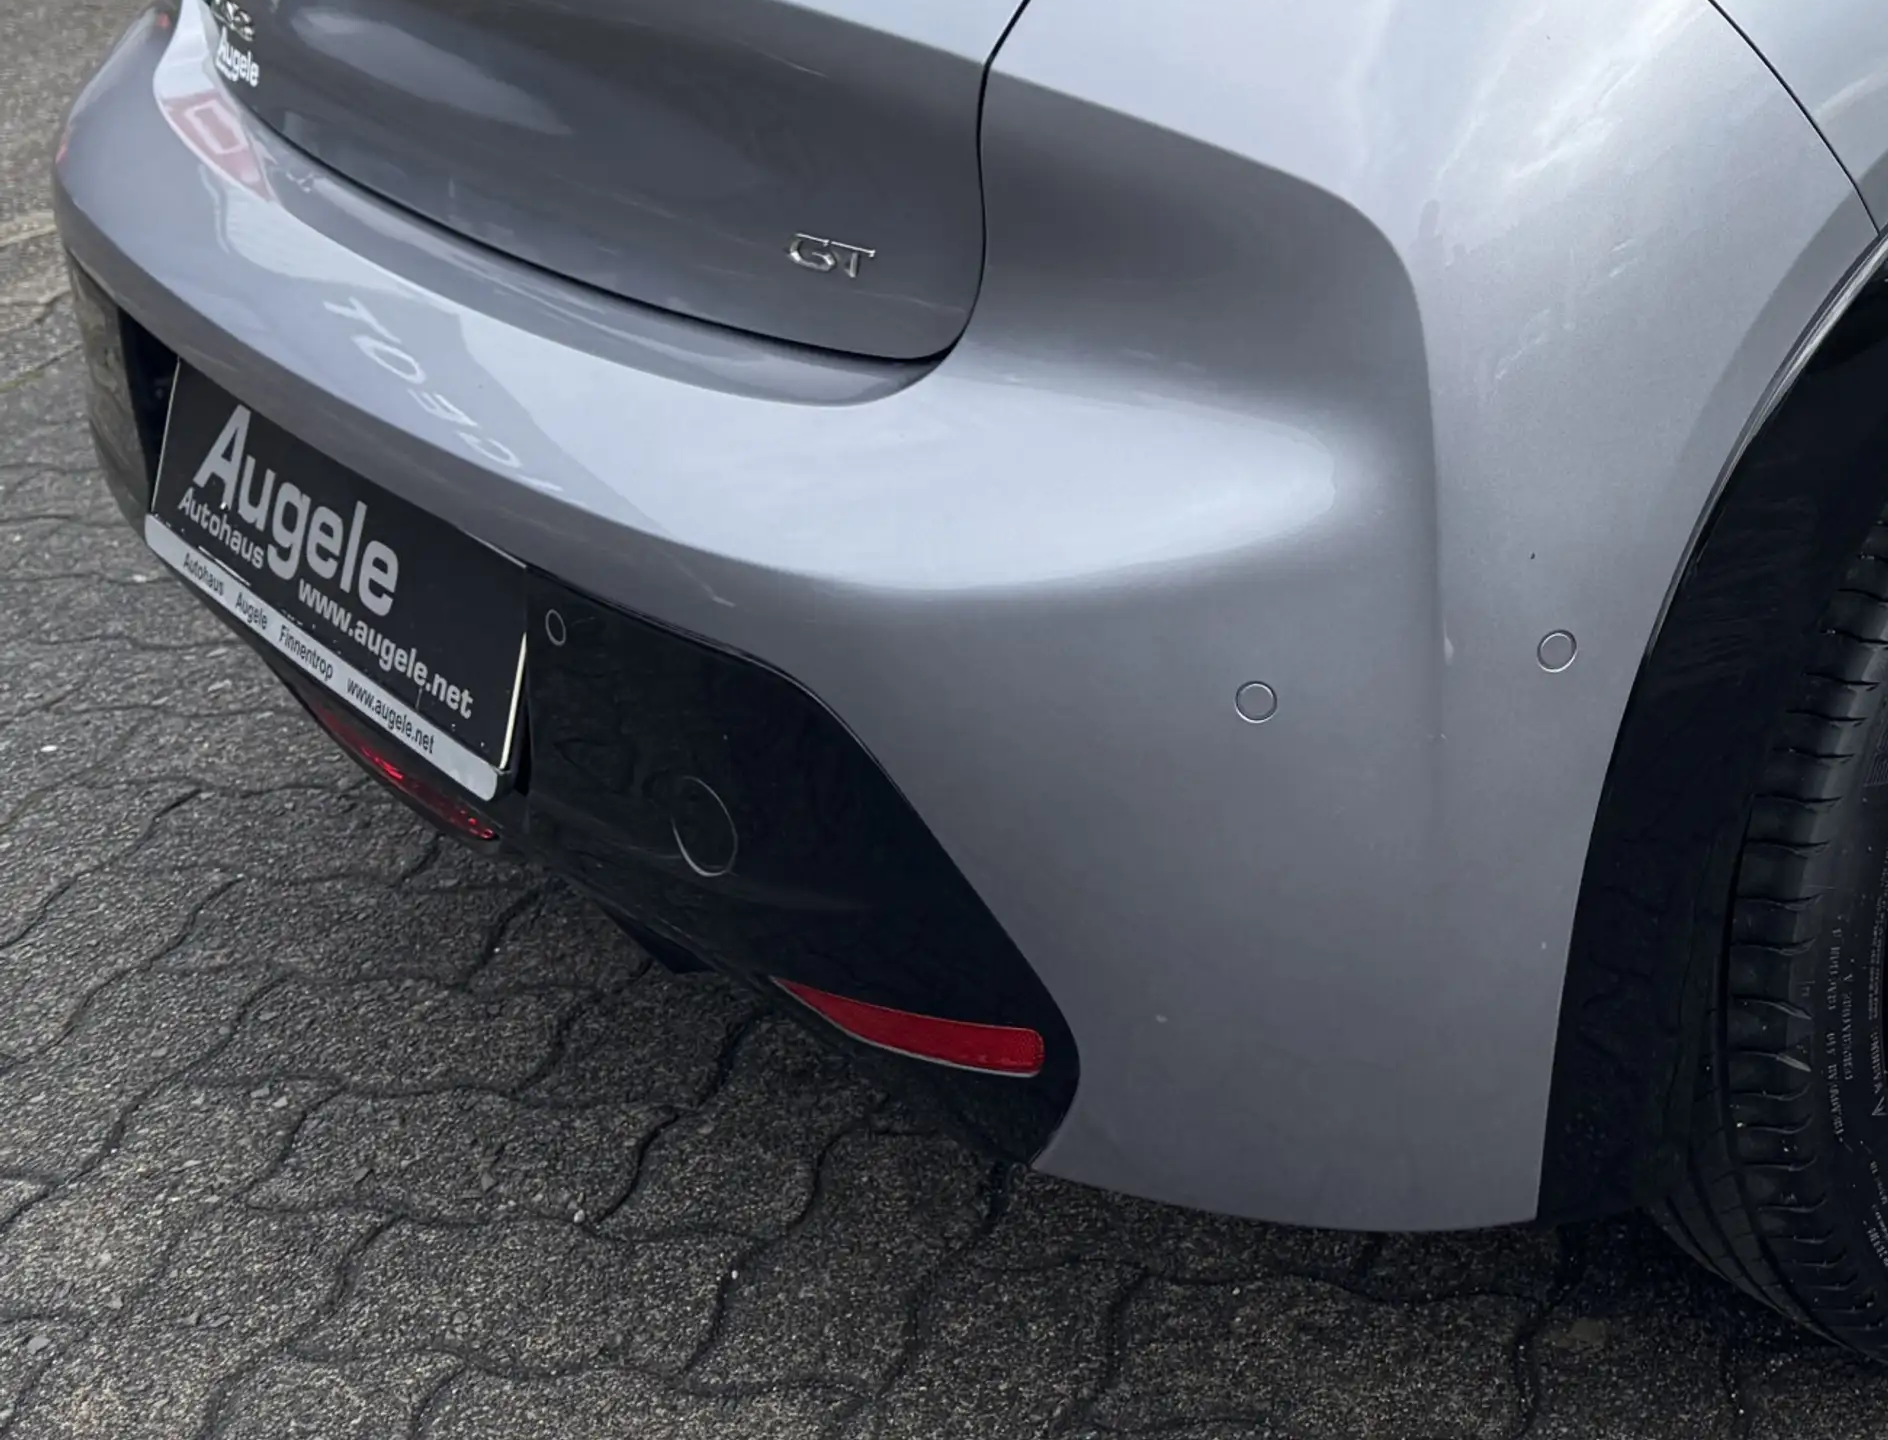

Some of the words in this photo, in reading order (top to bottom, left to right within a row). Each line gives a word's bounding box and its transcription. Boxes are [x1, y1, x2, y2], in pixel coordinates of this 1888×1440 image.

[217, 26, 260, 87] Augele
[789, 231, 876, 279] GT
[178, 487, 265, 570] Autohaus
[193, 404, 399, 617] Augele
[183, 552, 225, 596] Autohaus
[235, 591, 268, 630] Augele
[278, 624, 334, 681] Finnentrop
[345, 678, 435, 754] www.augele.net
[298, 578, 474, 720] www.augele.net
